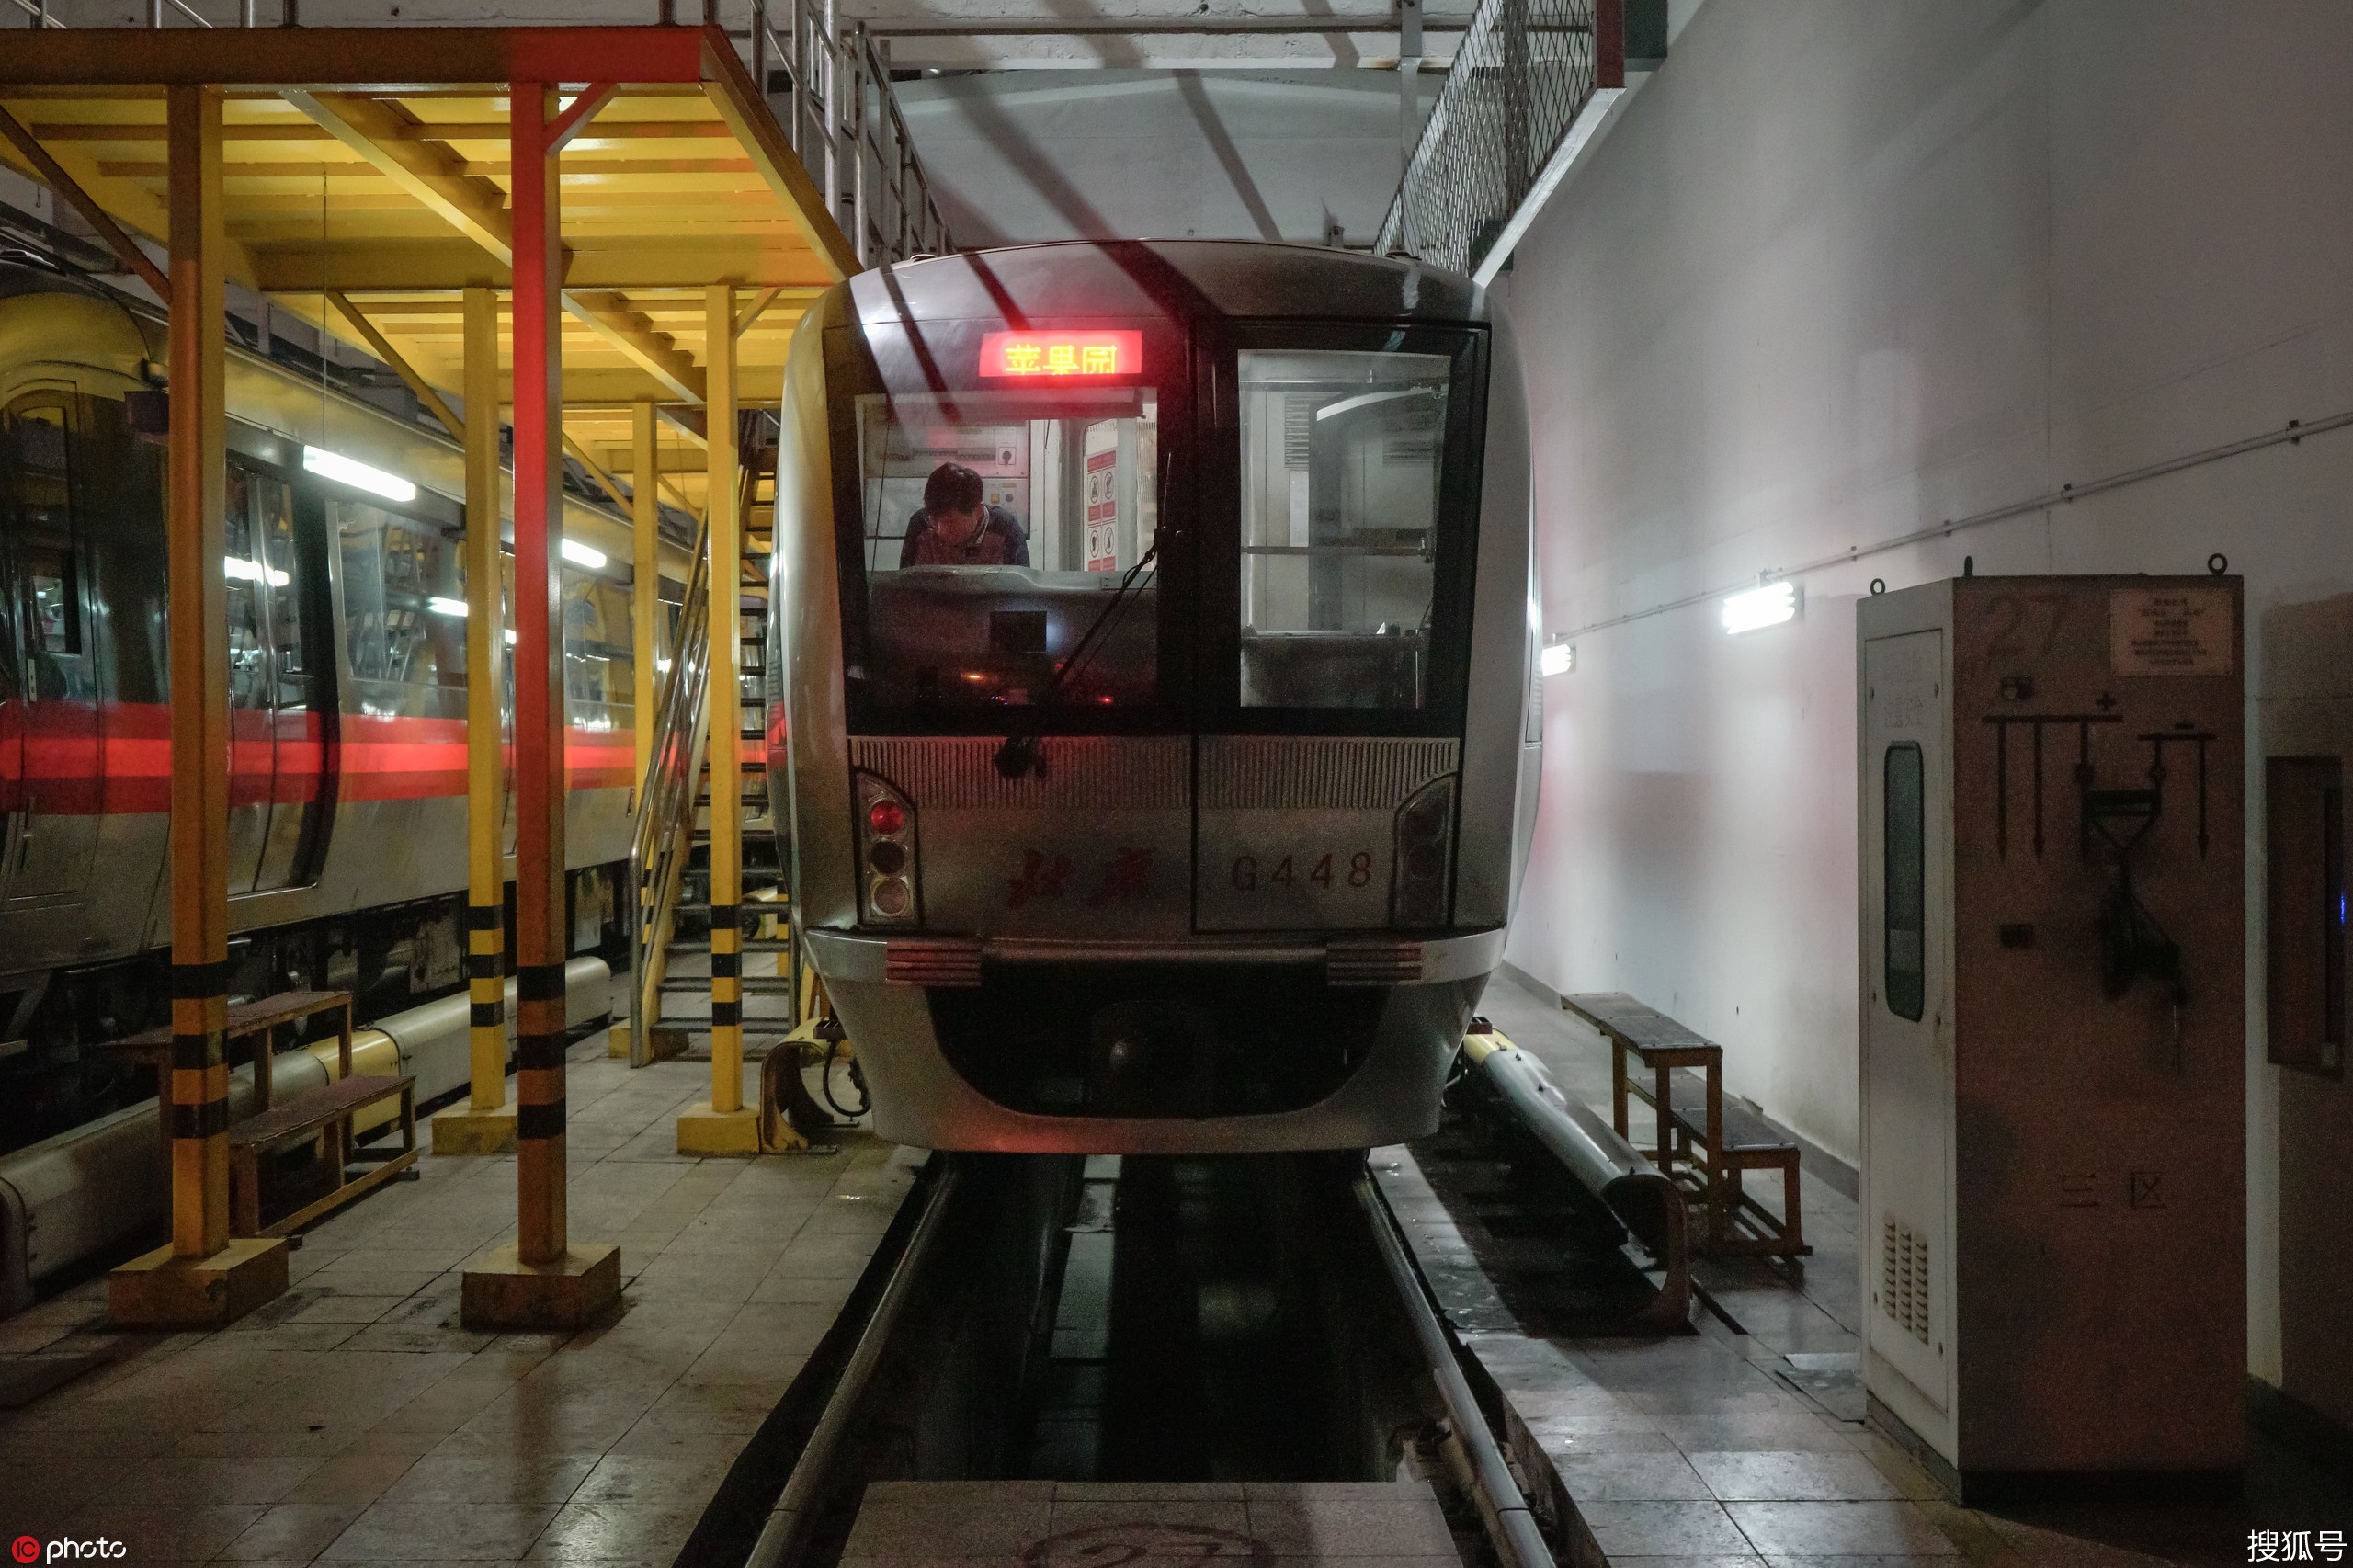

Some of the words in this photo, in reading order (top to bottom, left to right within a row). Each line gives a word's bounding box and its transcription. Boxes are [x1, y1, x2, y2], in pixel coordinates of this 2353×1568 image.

[1005, 344, 1117, 375] 苹果园
[1984, 592, 2071, 656] 27
[1232, 852, 1371, 892] G448
